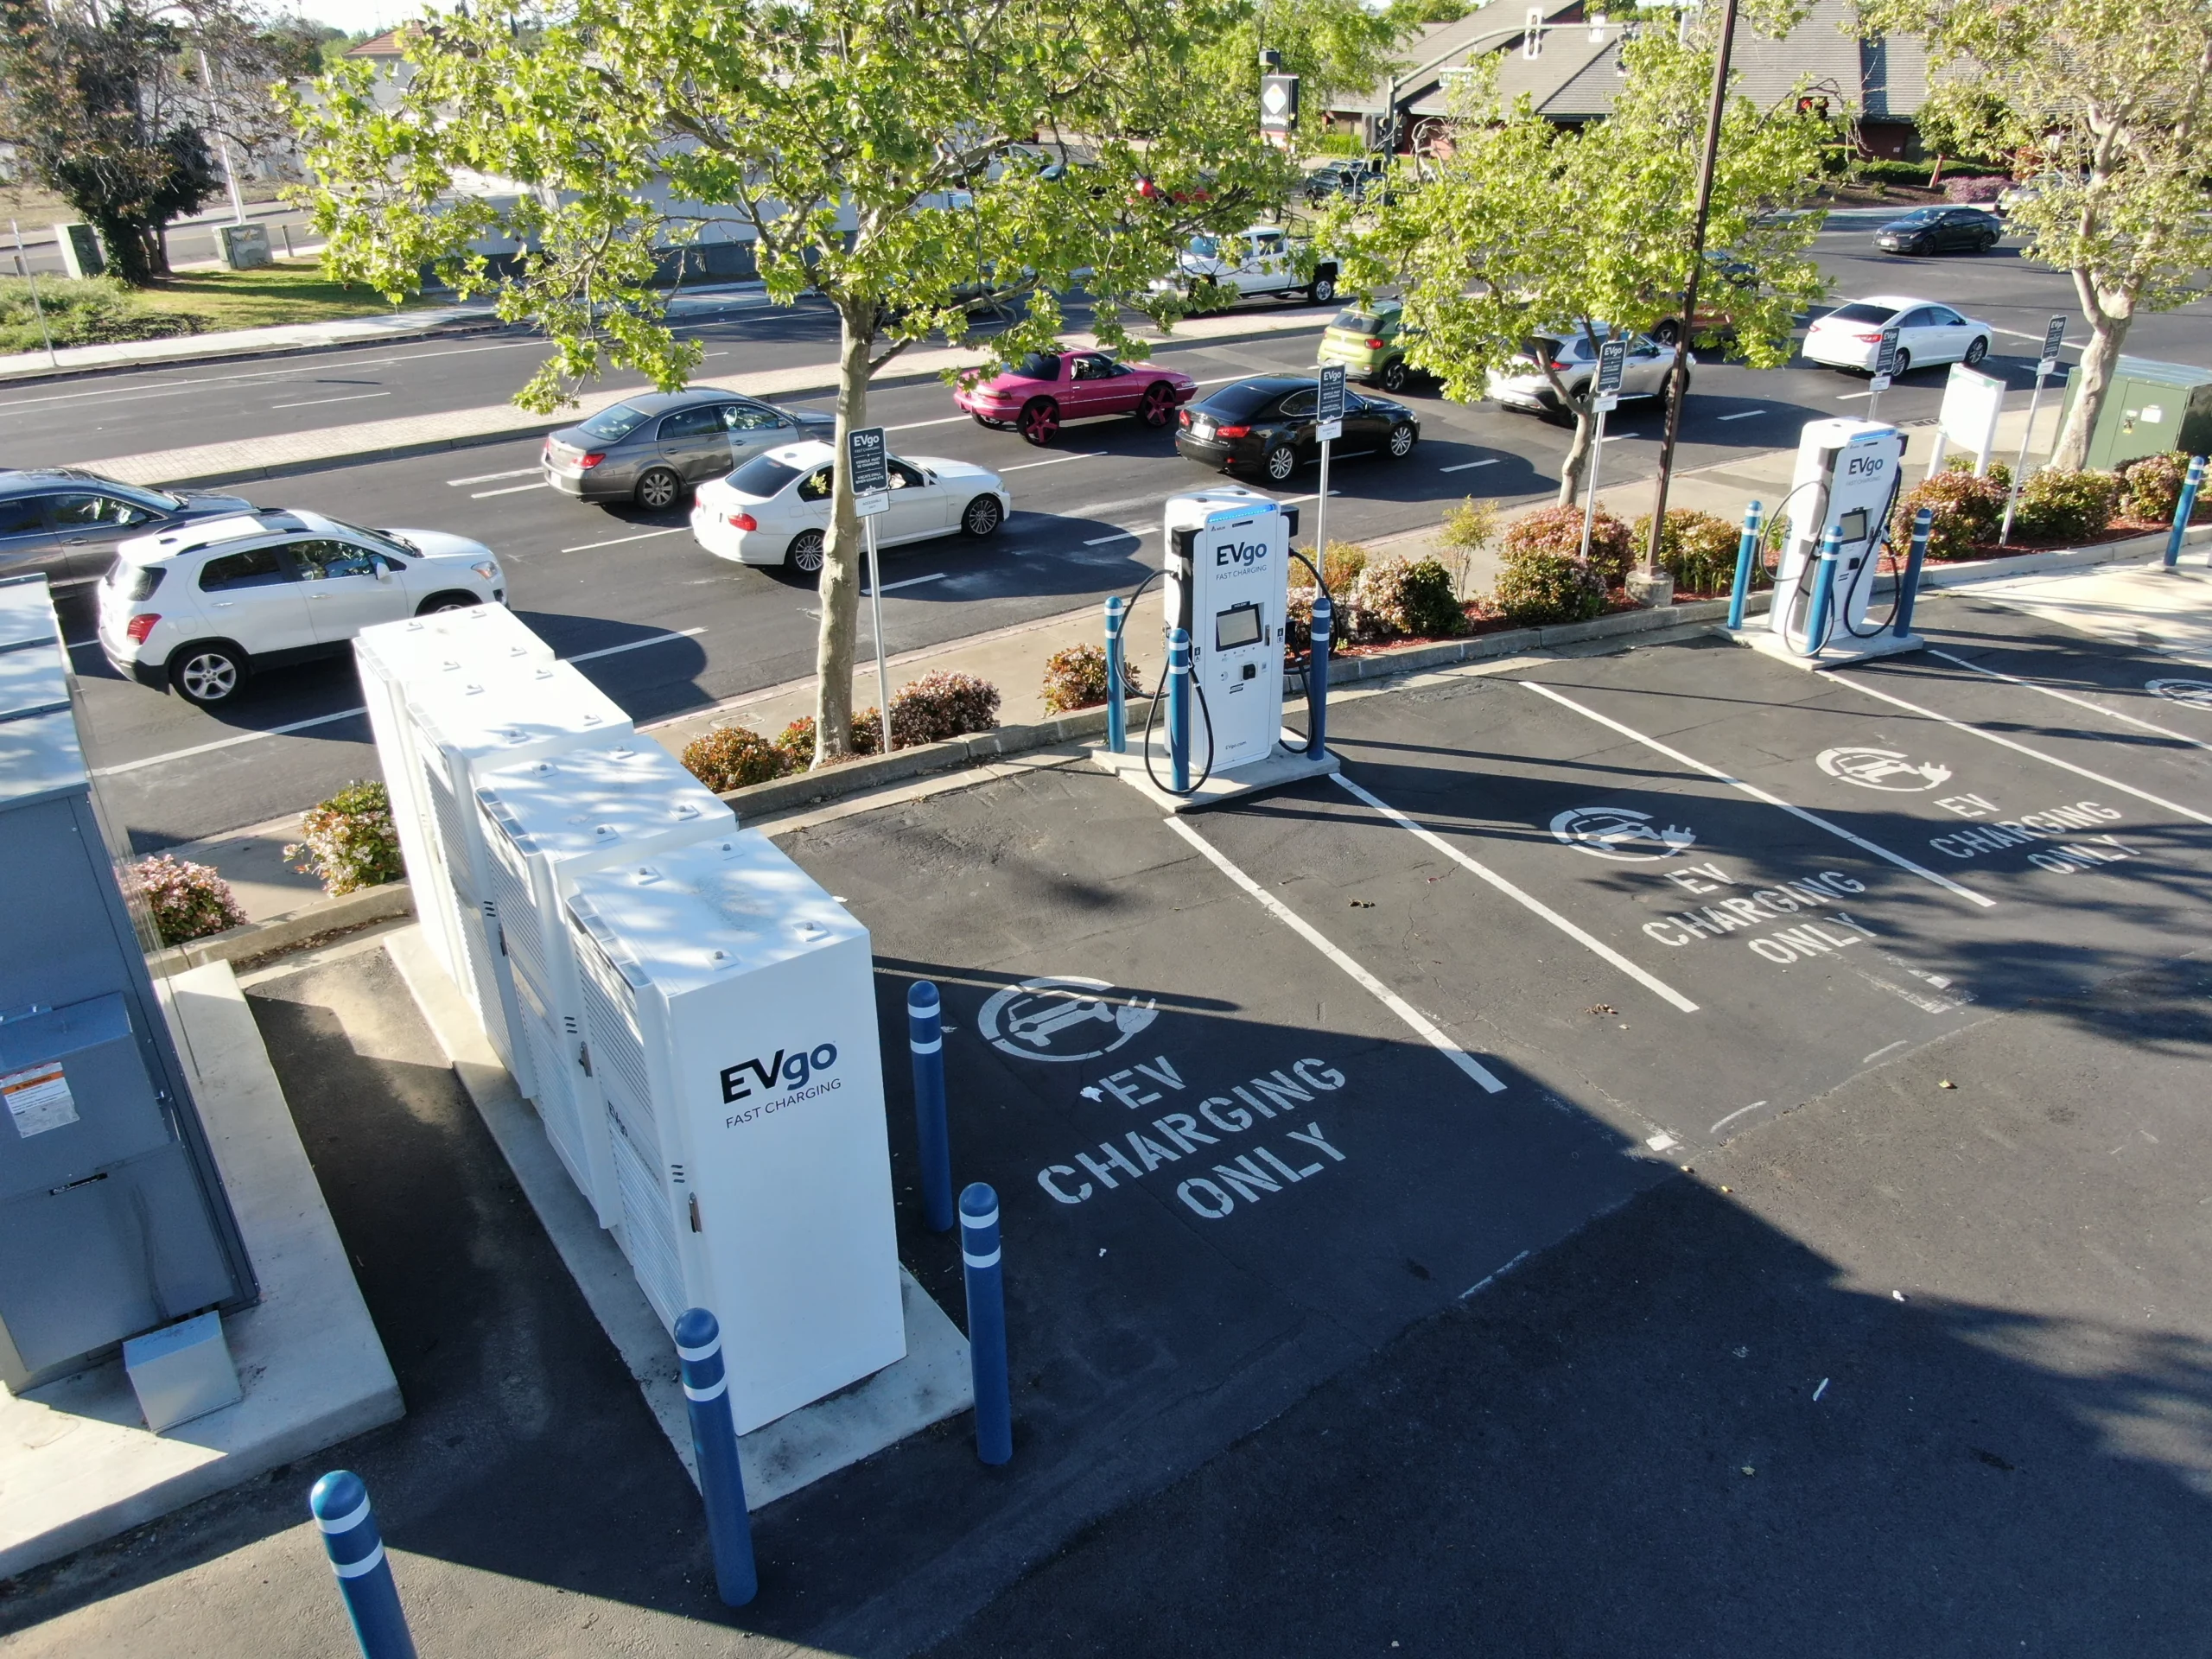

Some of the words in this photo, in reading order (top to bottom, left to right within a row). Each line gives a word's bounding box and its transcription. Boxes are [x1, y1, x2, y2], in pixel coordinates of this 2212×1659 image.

[1605, 346, 1623, 357] EVgo
[1884, 332, 1897, 341] EVgo
[1324, 371, 1342, 381] EVgo
[854, 435, 880, 447] EVgo
[1848, 456, 1884, 476] EVgo
[1217, 541, 1268, 567] EVgo
[1216, 572, 1232, 581] FAST
[1233, 564, 1268, 577] CHARGING
[1933, 793, 2001, 818] EV
[1929, 801, 2122, 858] CHARGING
[2027, 834, 2140, 874] ONLY
[1663, 862, 1738, 894] EV
[1642, 871, 1866, 947] CHARGING
[1748, 912, 1877, 964] ONLY
[720, 1043, 837, 1104] EVgo
[1098, 1055, 1186, 1109] EV
[726, 1107, 761, 1128] FAST
[765, 1078, 842, 1114] CHARGING
[1037, 1058, 1346, 1204] CHARGING
[1176, 1122, 1347, 1218] ONLY
